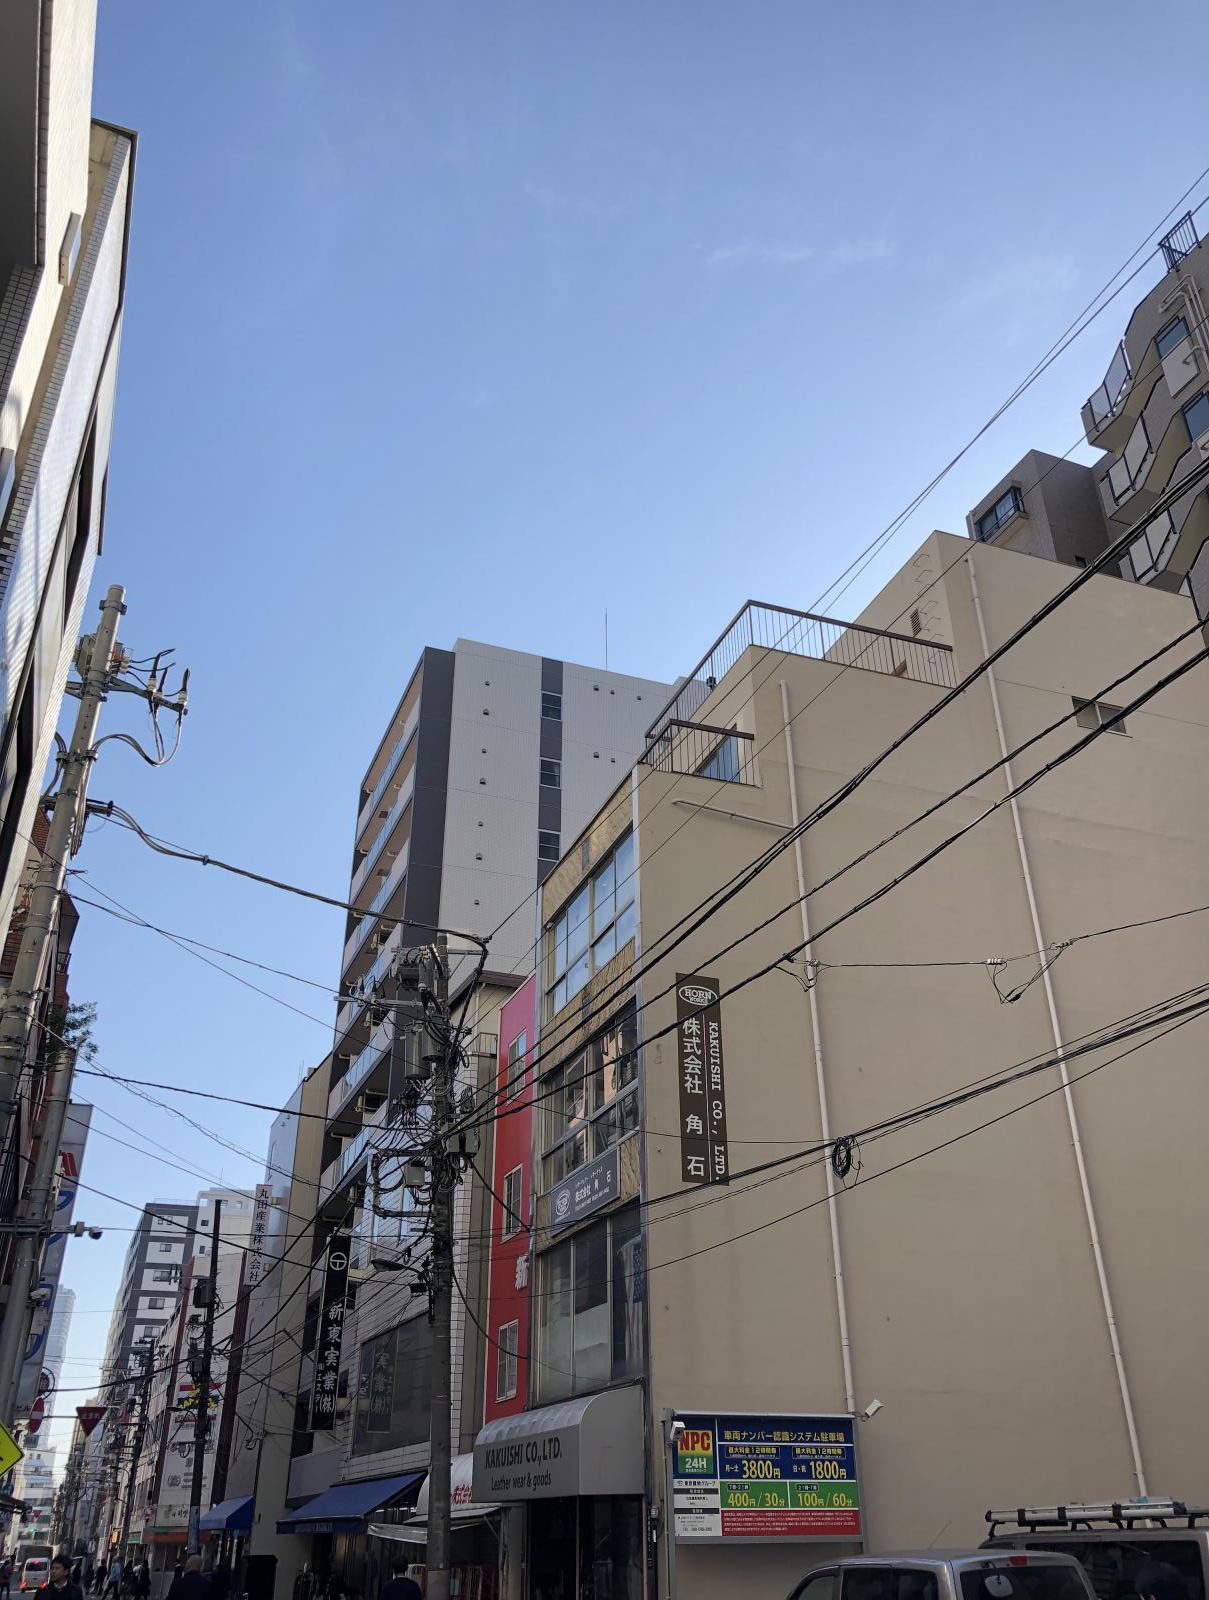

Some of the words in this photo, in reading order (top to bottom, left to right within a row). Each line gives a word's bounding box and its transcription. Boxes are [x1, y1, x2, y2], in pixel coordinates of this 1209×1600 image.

[684, 988, 712, 1000] HORN
[708, 1021, 722, 1092] KAKUISHI
[711, 1100, 723, 1135] CO.,
[714, 1145, 726, 1181] LTD.
[679, 1431, 711, 1451] NPC
[485, 1441, 524, 1469] KAKUISHI
[685, 1458, 707, 1469] 24H
[741, 1460, 781, 1479] 3800円
[809, 1460, 847, 1479] 1800円
[491, 1473, 512, 1491] Leather
[512, 1475, 526, 1489] wear
[526, 1472, 532, 1487] &
[532, 1470, 552, 1492] goods
